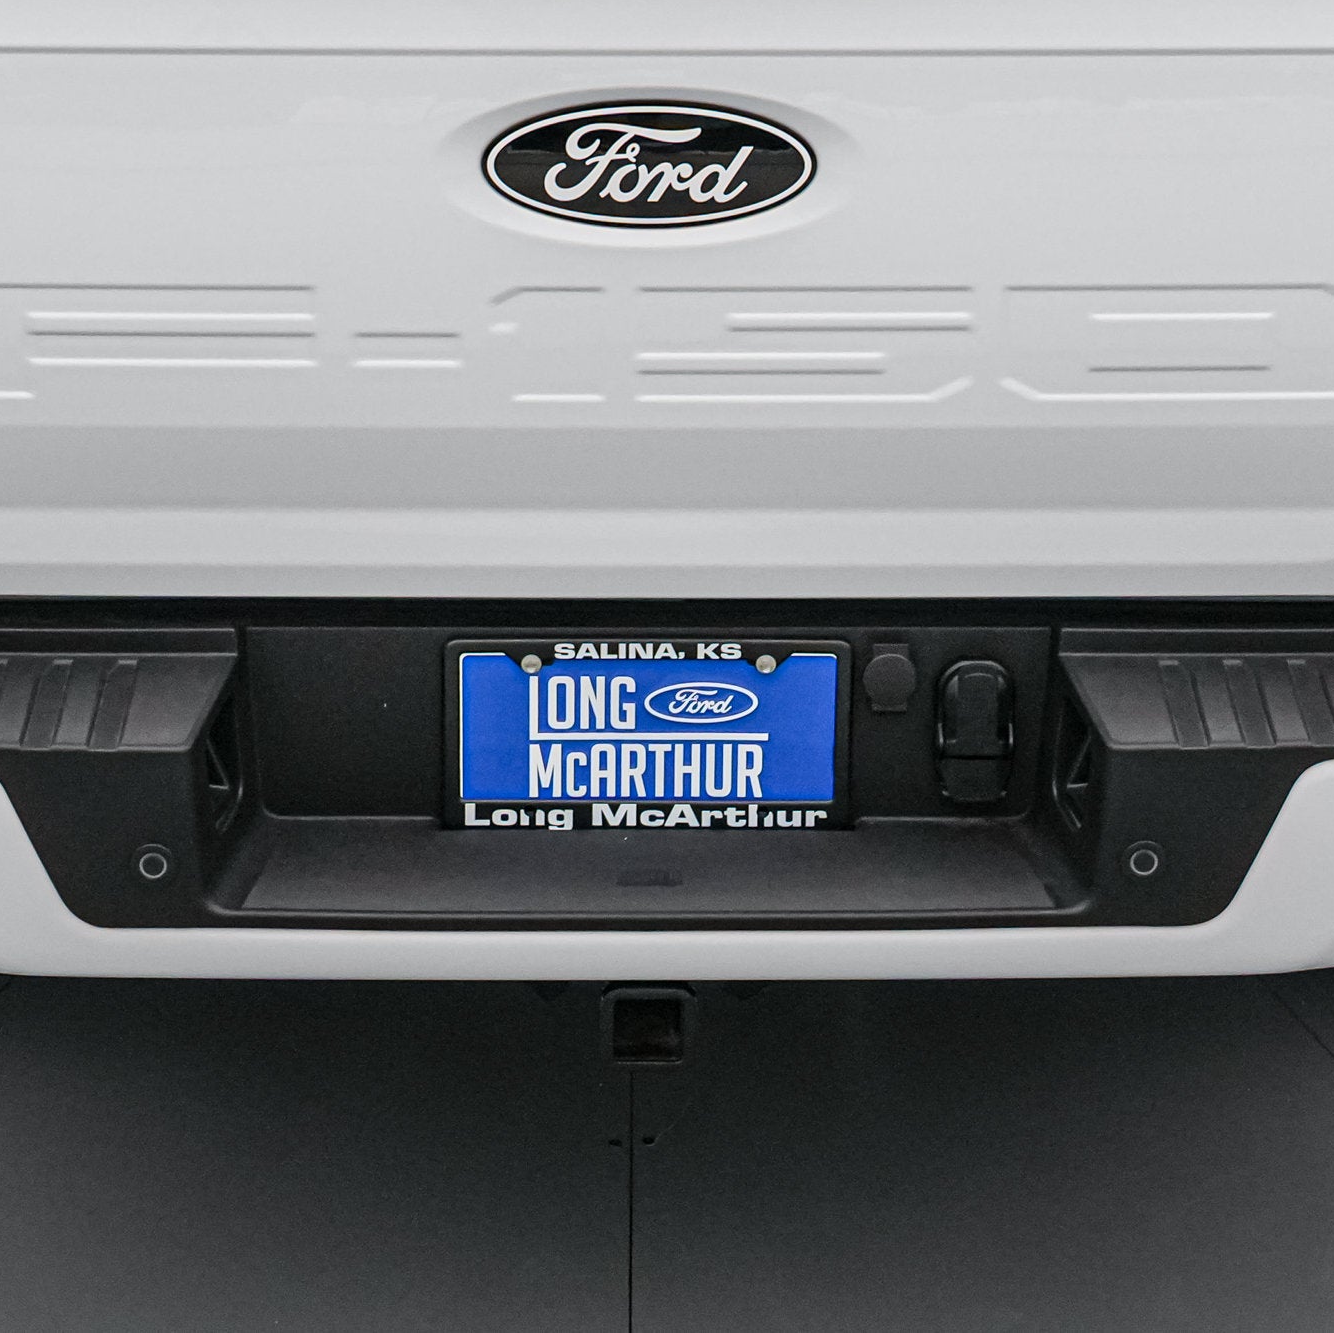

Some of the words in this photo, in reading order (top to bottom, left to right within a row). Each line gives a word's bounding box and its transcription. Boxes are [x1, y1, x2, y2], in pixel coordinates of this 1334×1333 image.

[543, 122, 755, 204] Ford
[553, 642, 686, 660] SALINA,
[696, 642, 743, 660] KS
[529, 675, 636, 739] LONG
[668, 686, 734, 716] Ford
[528, 743, 764, 798] McARTHUR
[464, 803, 574, 831] Long
[591, 803, 828, 829] McArthur
